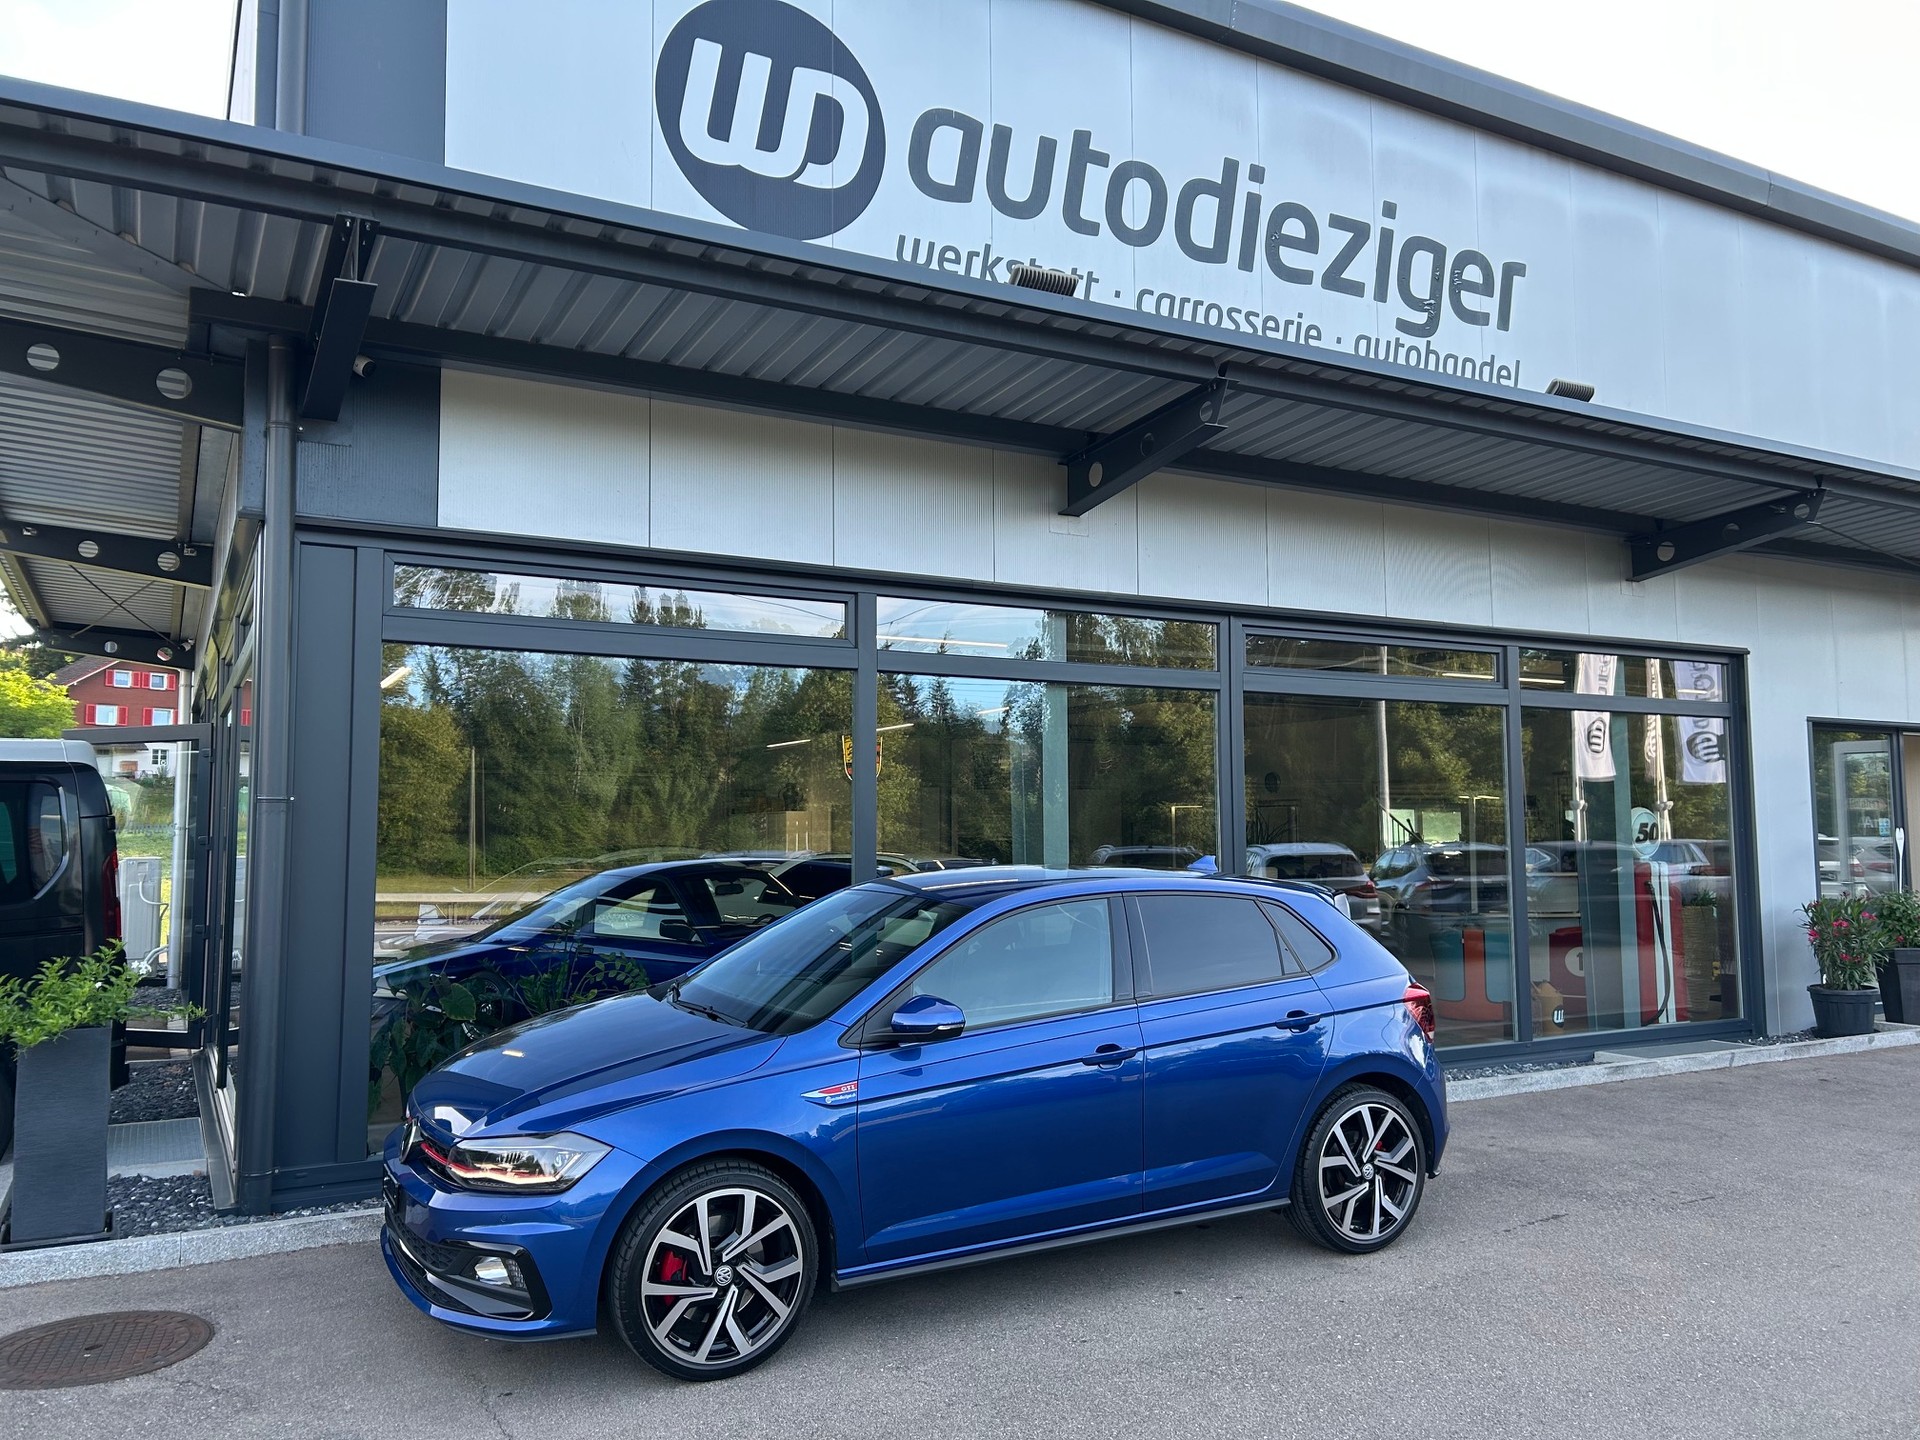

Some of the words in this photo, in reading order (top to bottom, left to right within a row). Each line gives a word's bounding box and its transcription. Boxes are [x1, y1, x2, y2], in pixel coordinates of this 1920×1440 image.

[907, 107, 1527, 338] autodieziger
[1136, 287, 1322, 346] carrosserie
[1353, 332, 1521, 388] autohandel
